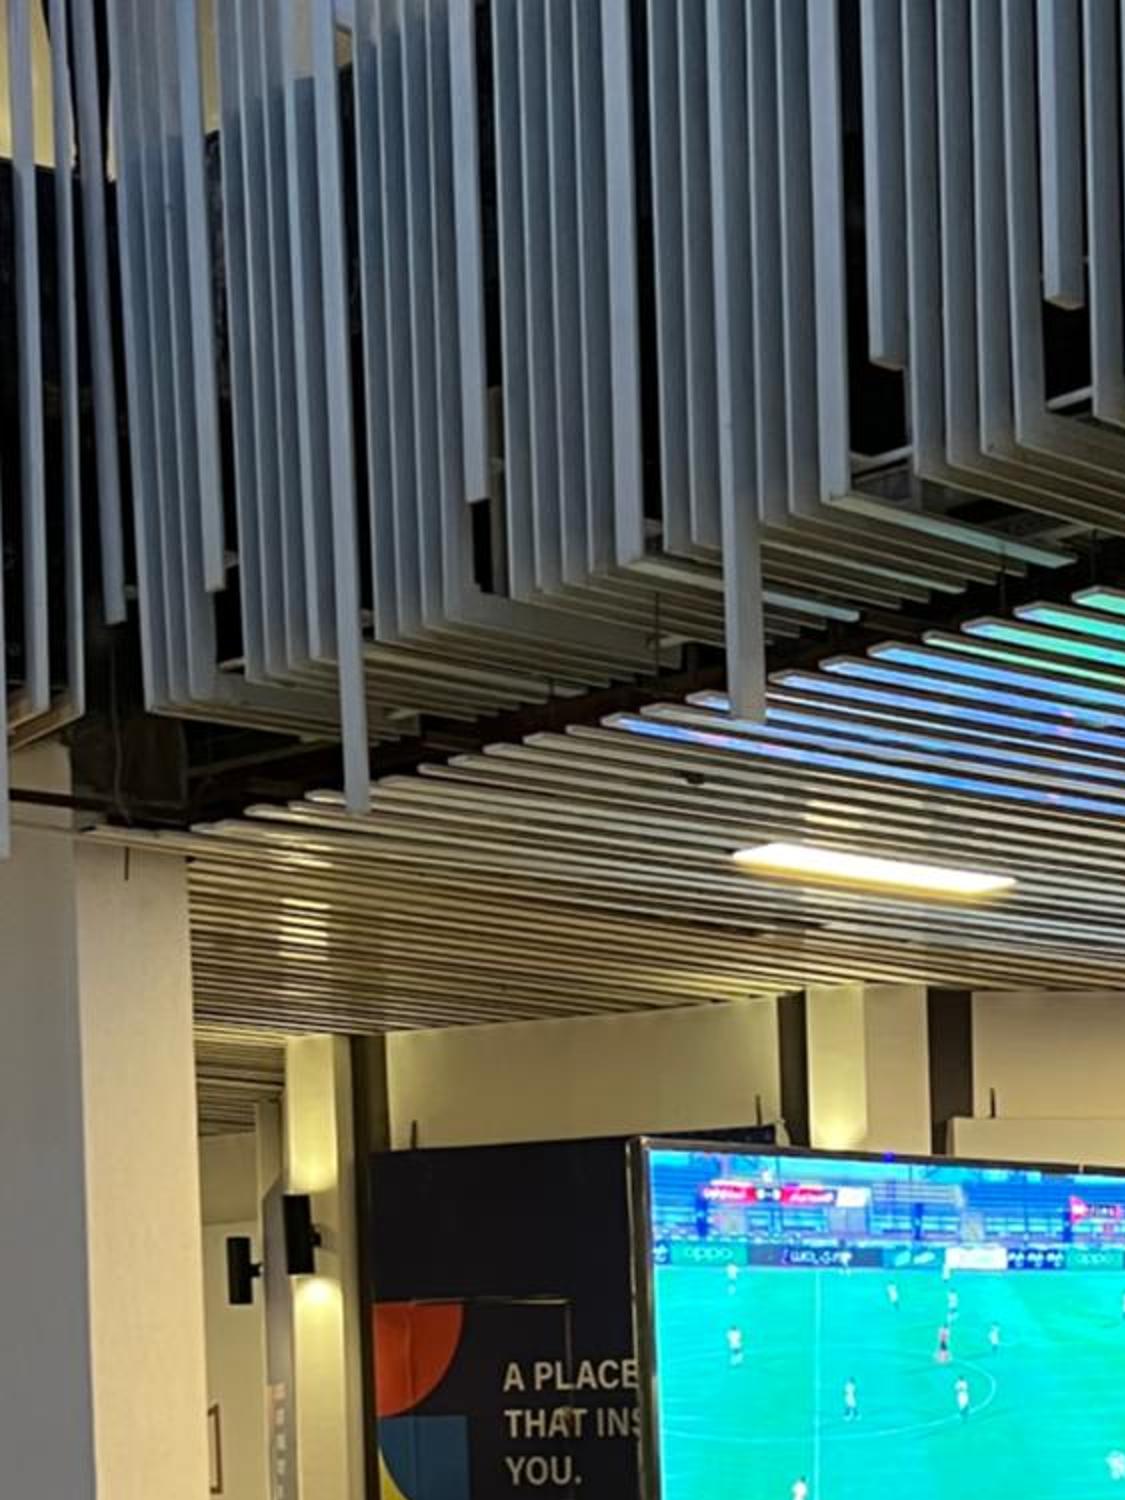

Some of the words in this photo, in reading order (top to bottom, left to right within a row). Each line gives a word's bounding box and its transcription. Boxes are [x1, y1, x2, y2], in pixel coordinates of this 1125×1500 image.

[503, 1362, 525, 1391] A
[534, 1359, 639, 1391] PLACE
[504, 1408, 588, 1438] THAT
[505, 1455, 582, 1485] YOU.
